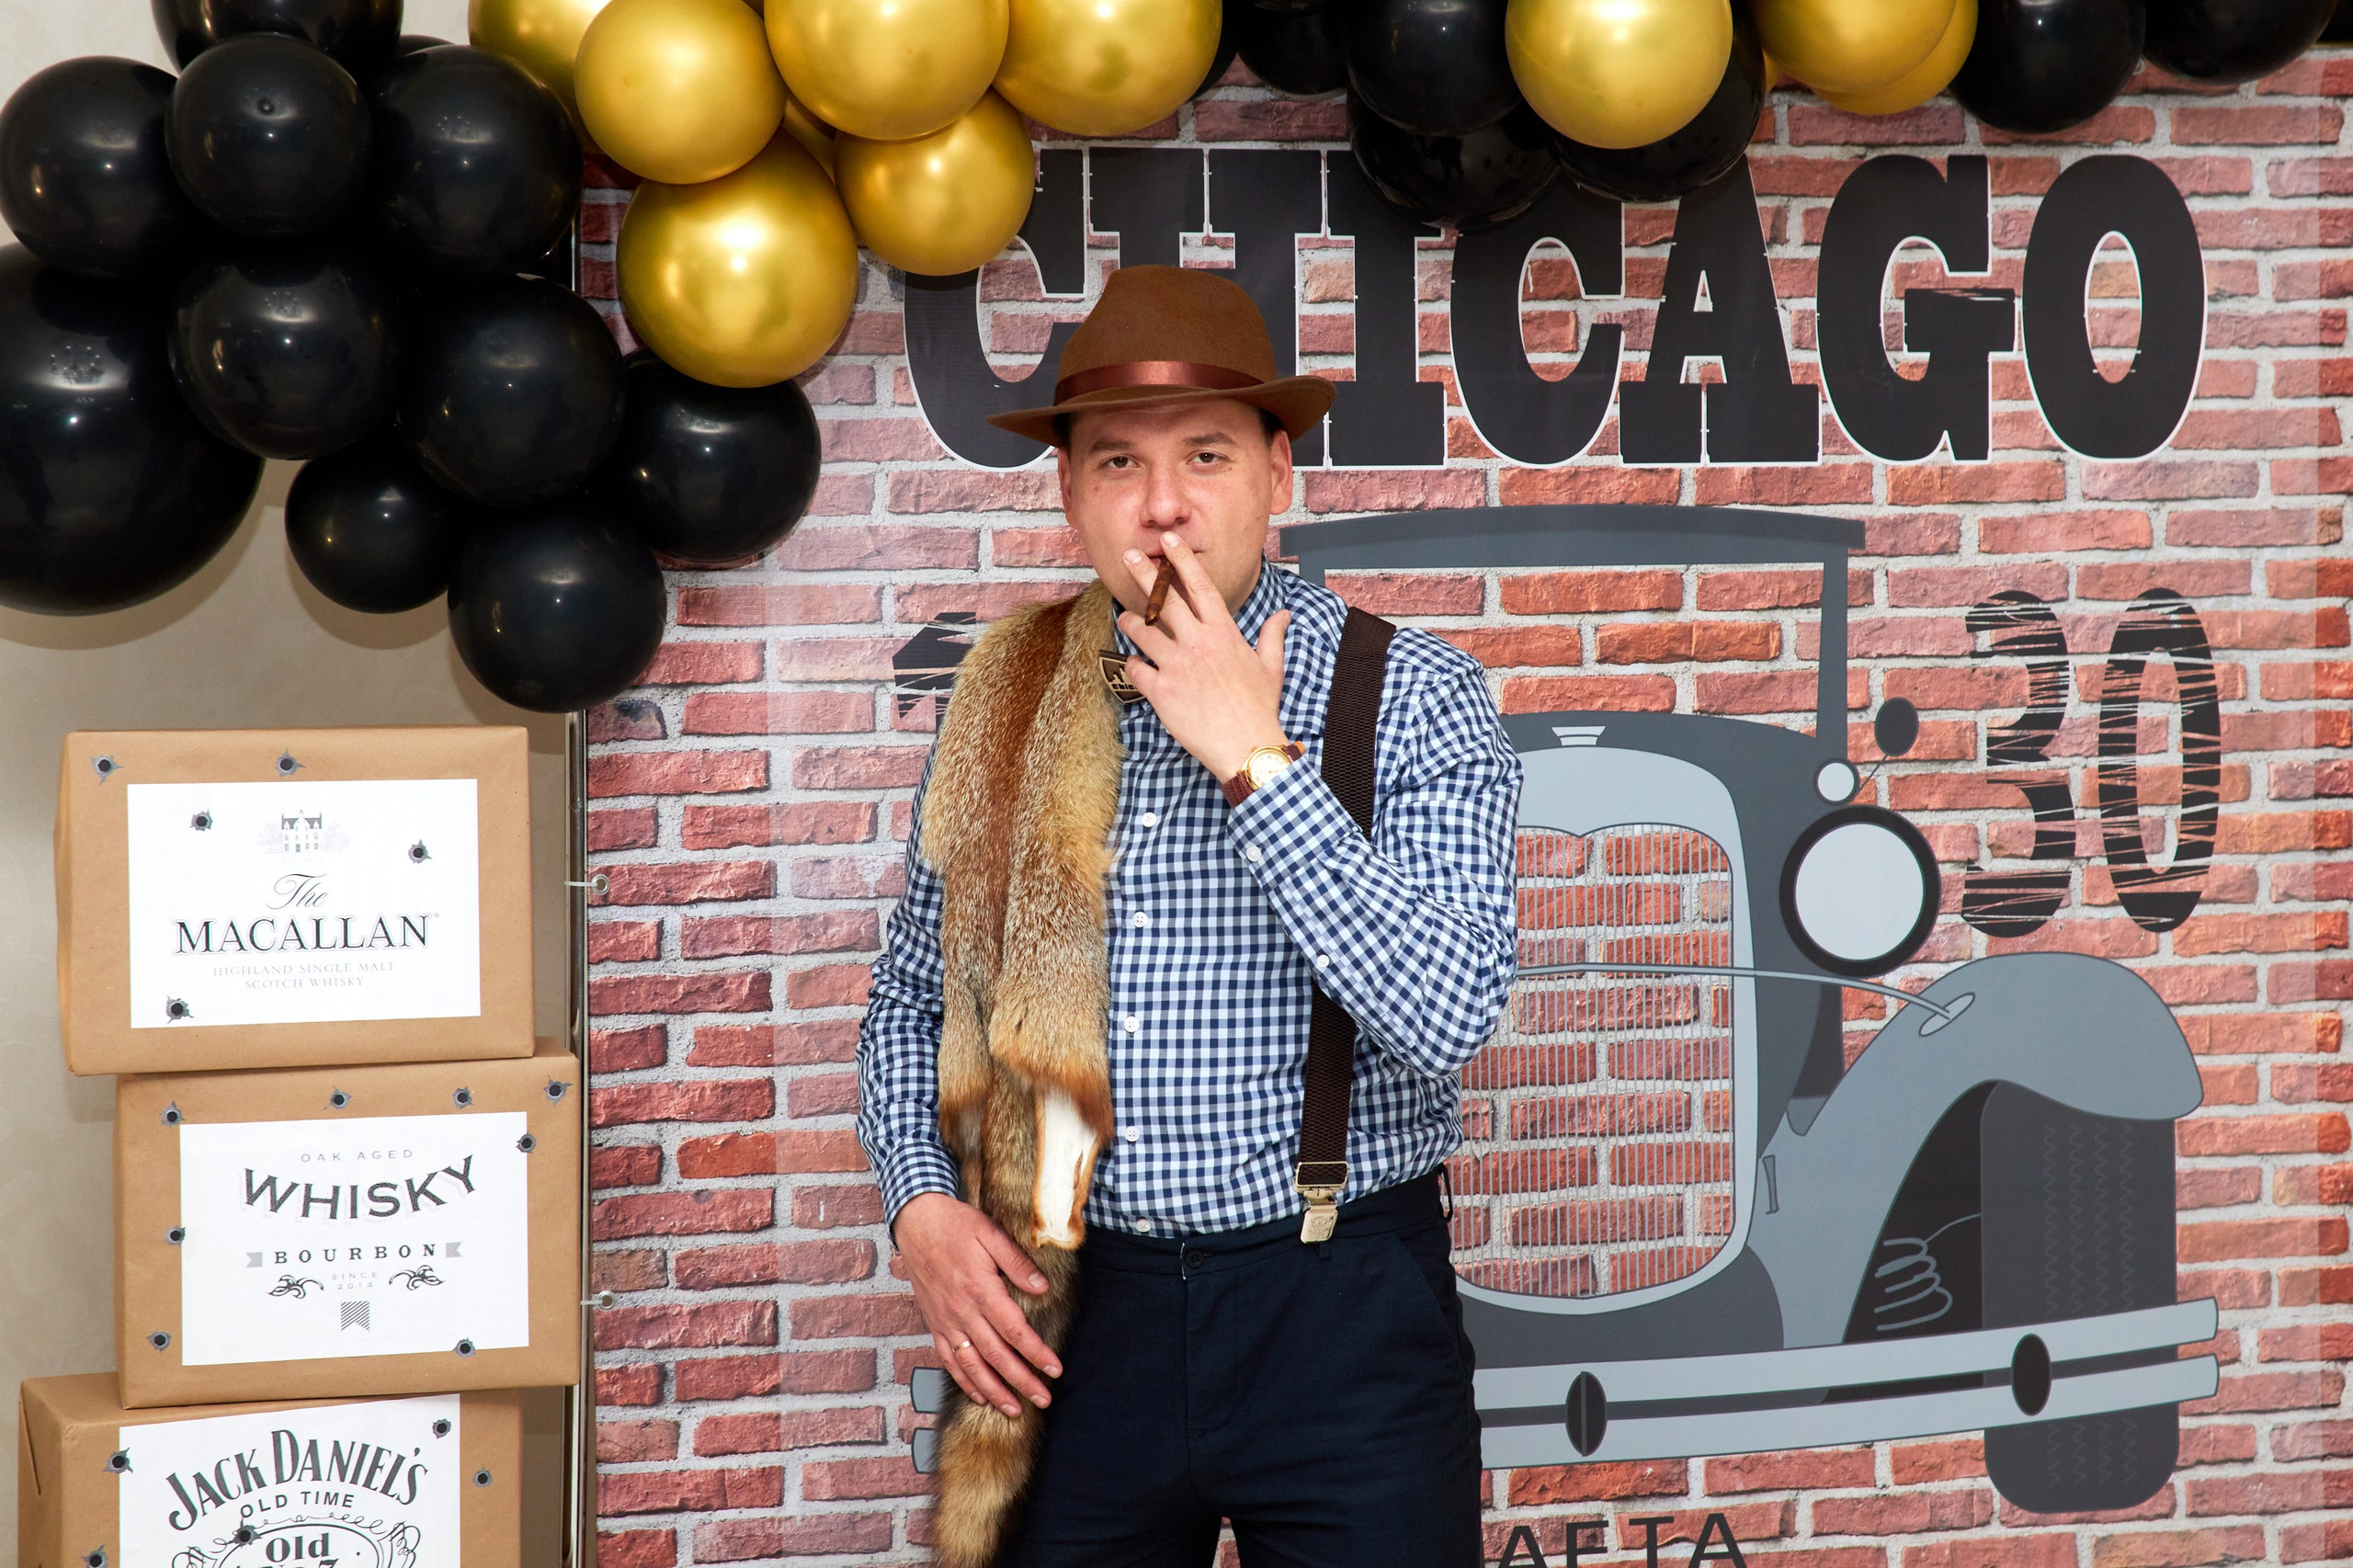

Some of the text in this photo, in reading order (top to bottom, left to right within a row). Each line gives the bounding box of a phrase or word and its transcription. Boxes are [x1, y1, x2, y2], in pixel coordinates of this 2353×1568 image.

[904, 146, 2208, 471] CHICAGO
[266, 873, 328, 910] The
[173, 914, 432, 955] MACALLAN
[213, 961, 396, 976] HIGHLAND SINGLE MALT
[244, 976, 365, 989] SCOTCH WHISKY
[301, 1149, 415, 1163] OAK AGED
[243, 1153, 476, 1221] WHISKY
[274, 1243, 438, 1265] BOURBON
[331, 1272, 379, 1280] SINCE
[337, 1281, 373, 1290] 2014
[165, 1448, 267, 1531] JACK
[240, 1490, 355, 1518] OLD TIME
[265, 1532, 330, 1562] Old
